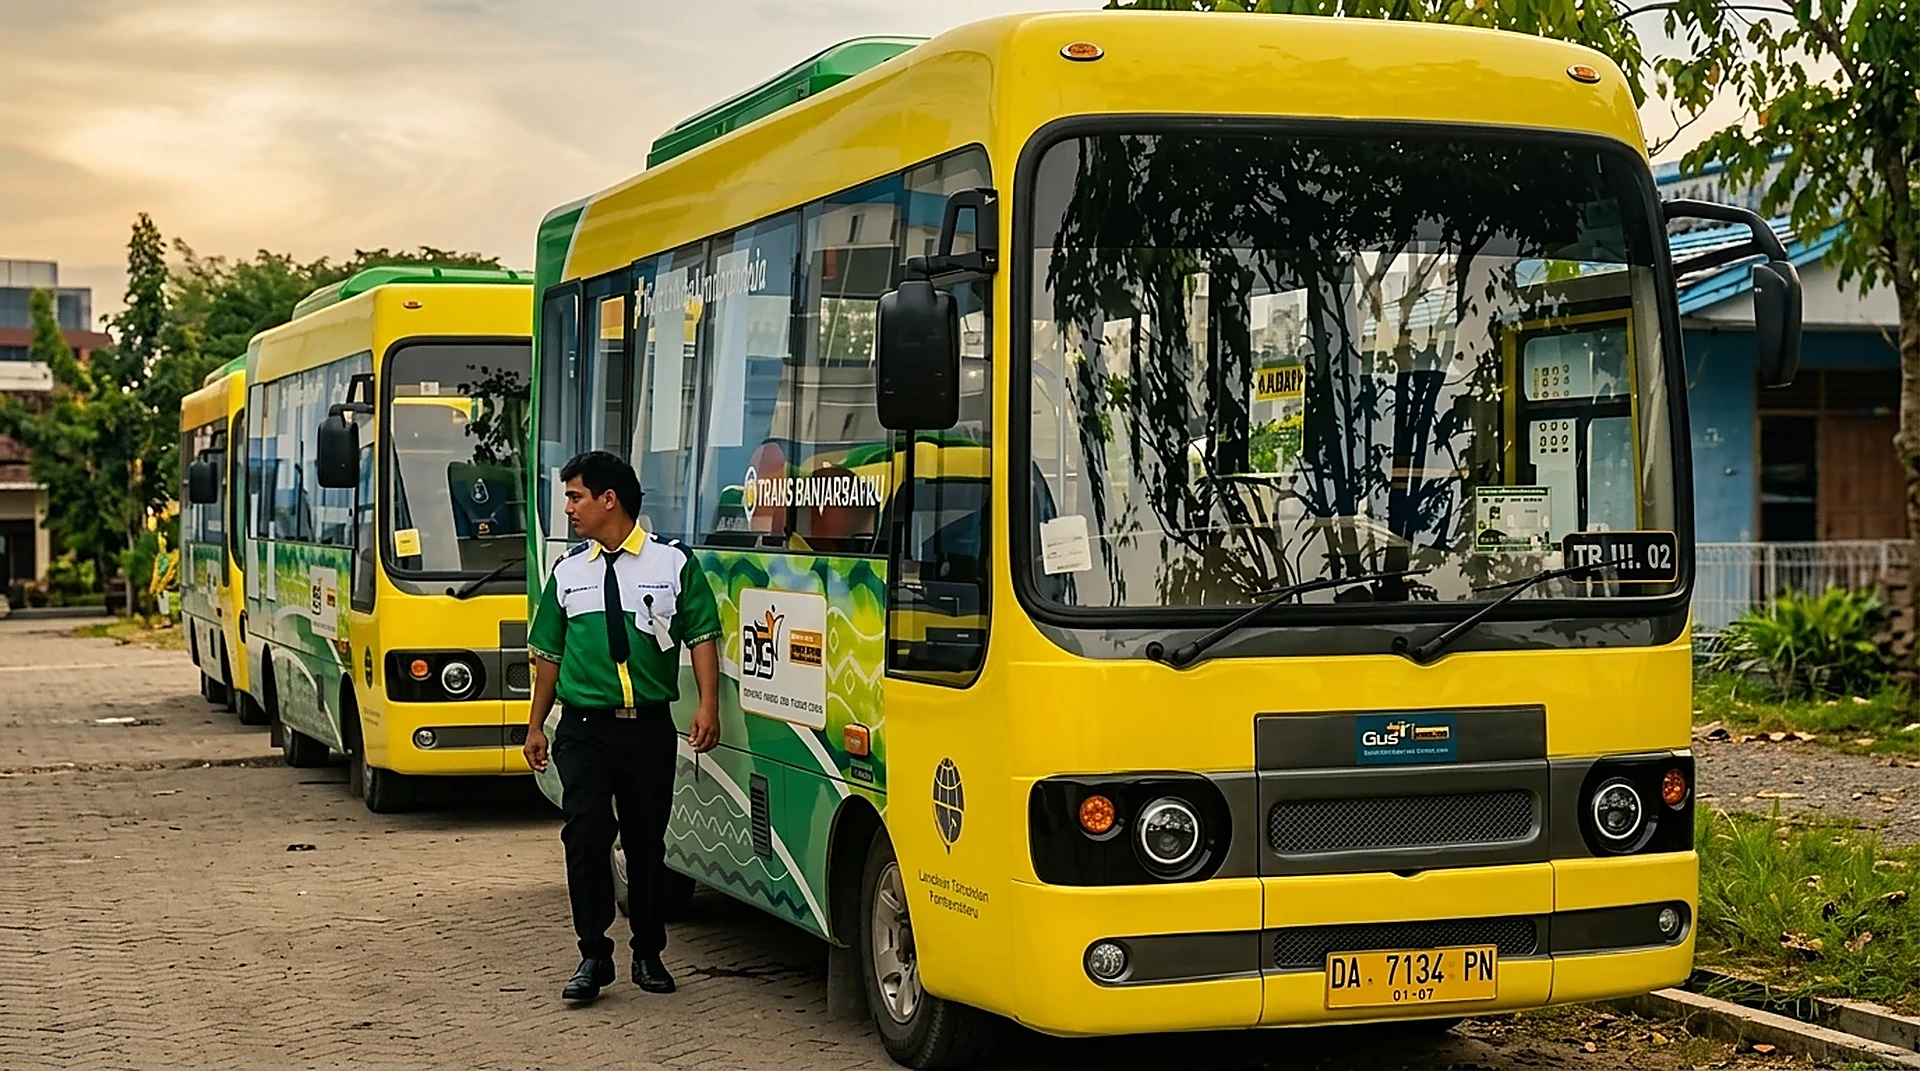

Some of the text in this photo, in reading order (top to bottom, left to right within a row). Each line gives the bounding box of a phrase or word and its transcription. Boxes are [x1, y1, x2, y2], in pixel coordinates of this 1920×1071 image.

[757, 478, 793, 506] TRANS
[1573, 544, 1603, 567] TR
[1647, 543, 1671, 569] 02
[1386, 953, 1444, 985] 7134
[1464, 950, 1493, 981] PN
[1393, 988, 1434, 1001] 01-07
